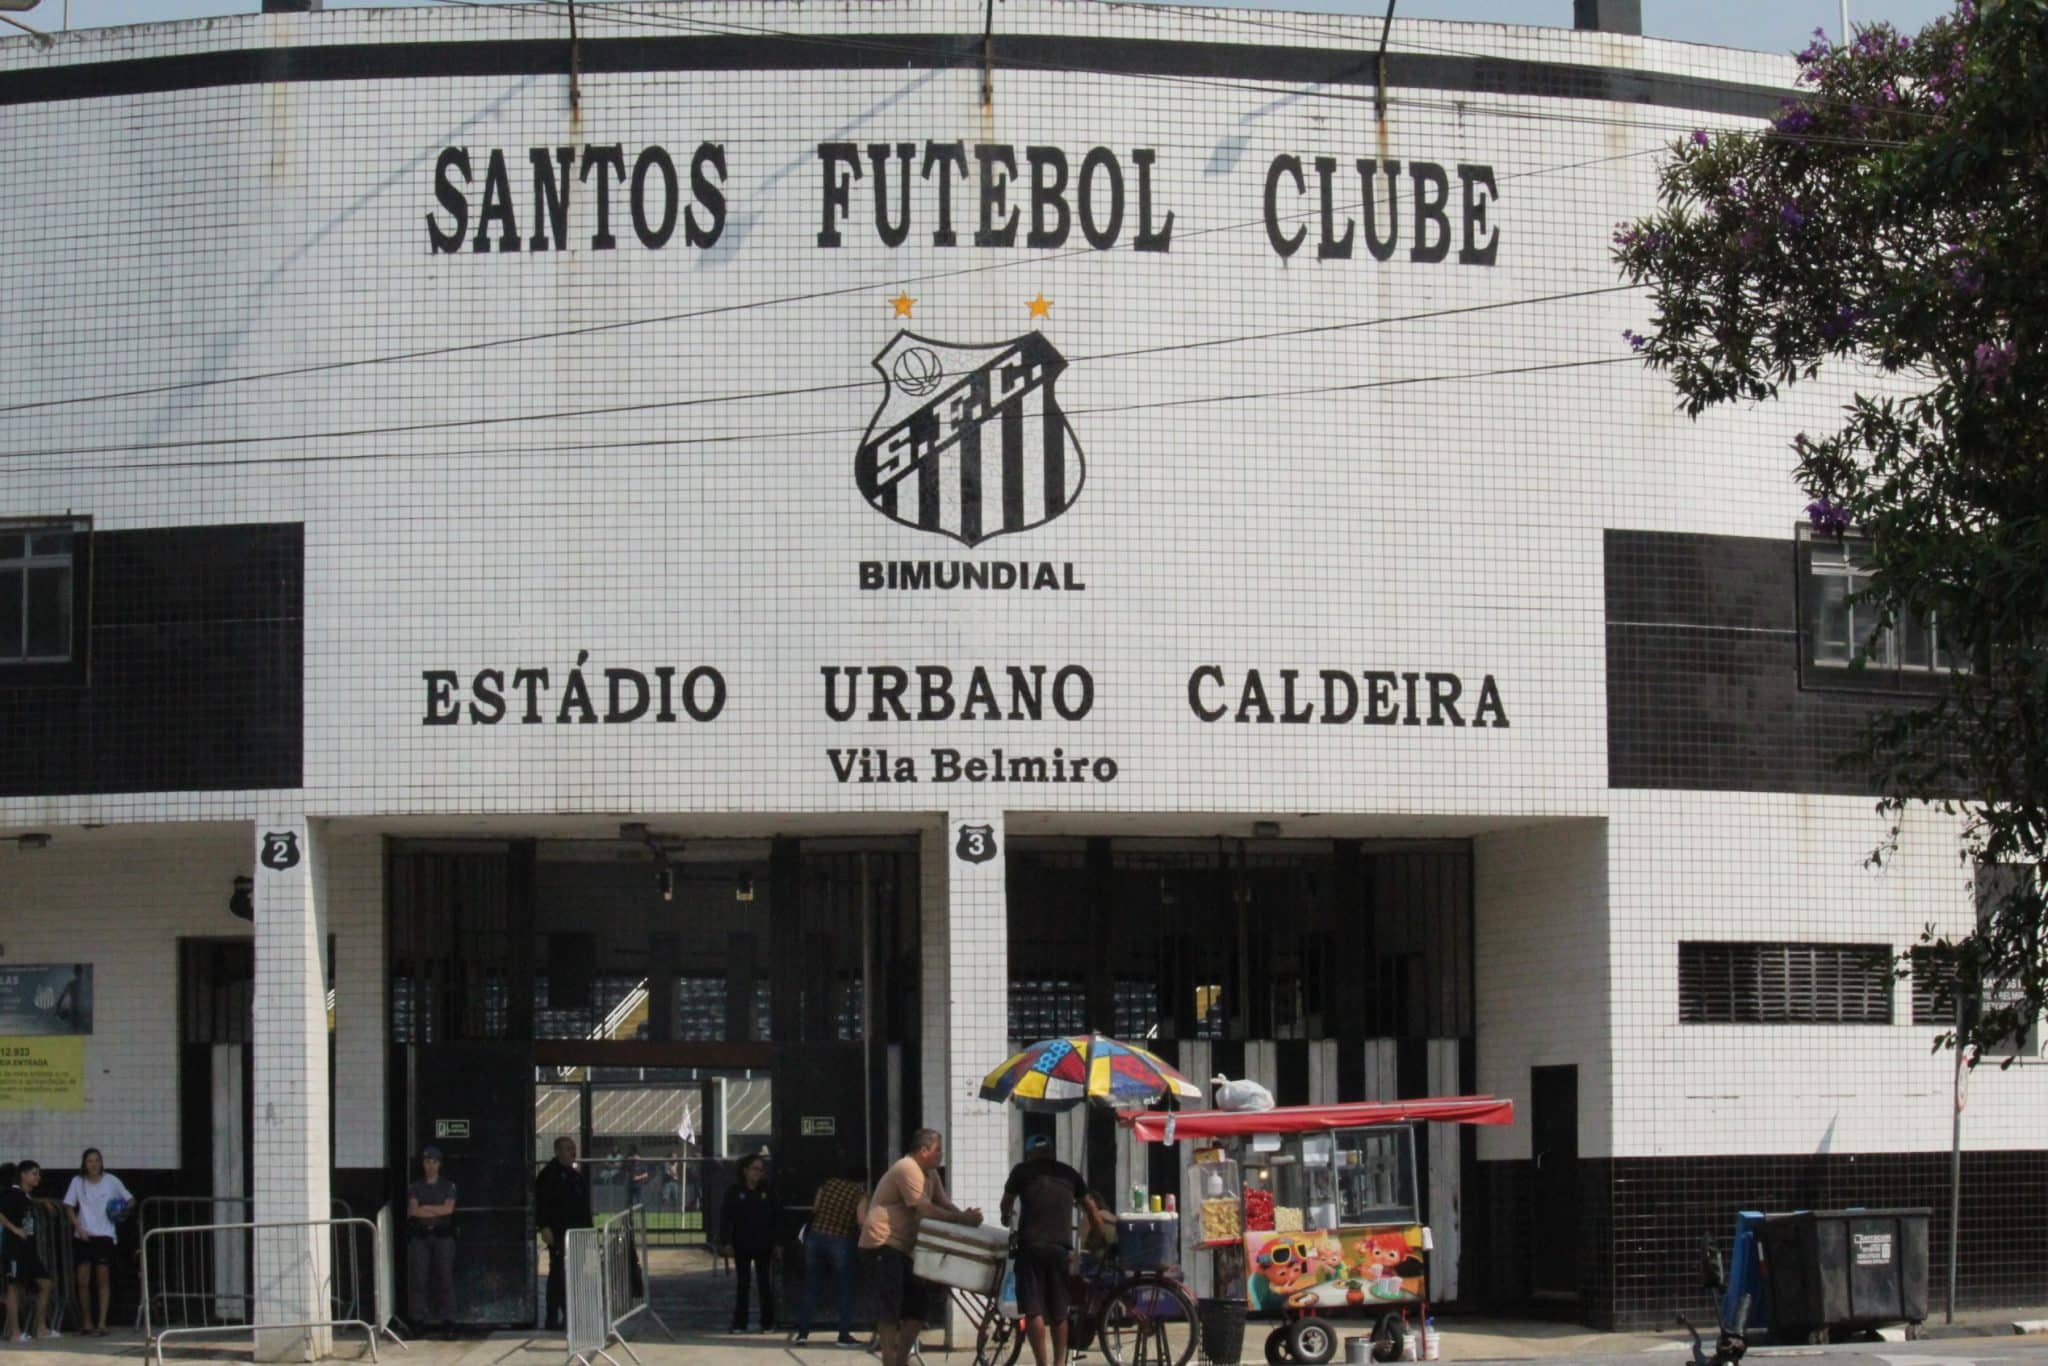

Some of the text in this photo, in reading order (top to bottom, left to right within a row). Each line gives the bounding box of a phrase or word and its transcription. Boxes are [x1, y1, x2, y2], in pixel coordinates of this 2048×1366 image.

[426, 139, 1499, 266] SANTOS FUTEBOL CLUBE
[859, 561, 1085, 590] BIMUNDIAL
[422, 649, 1509, 728] ESTÁDIO URBANO CALDEIRA
[826, 747, 1118, 783] Vila Belmiro
[273, 840, 289, 863] 2
[968, 834, 985, 856] 3
